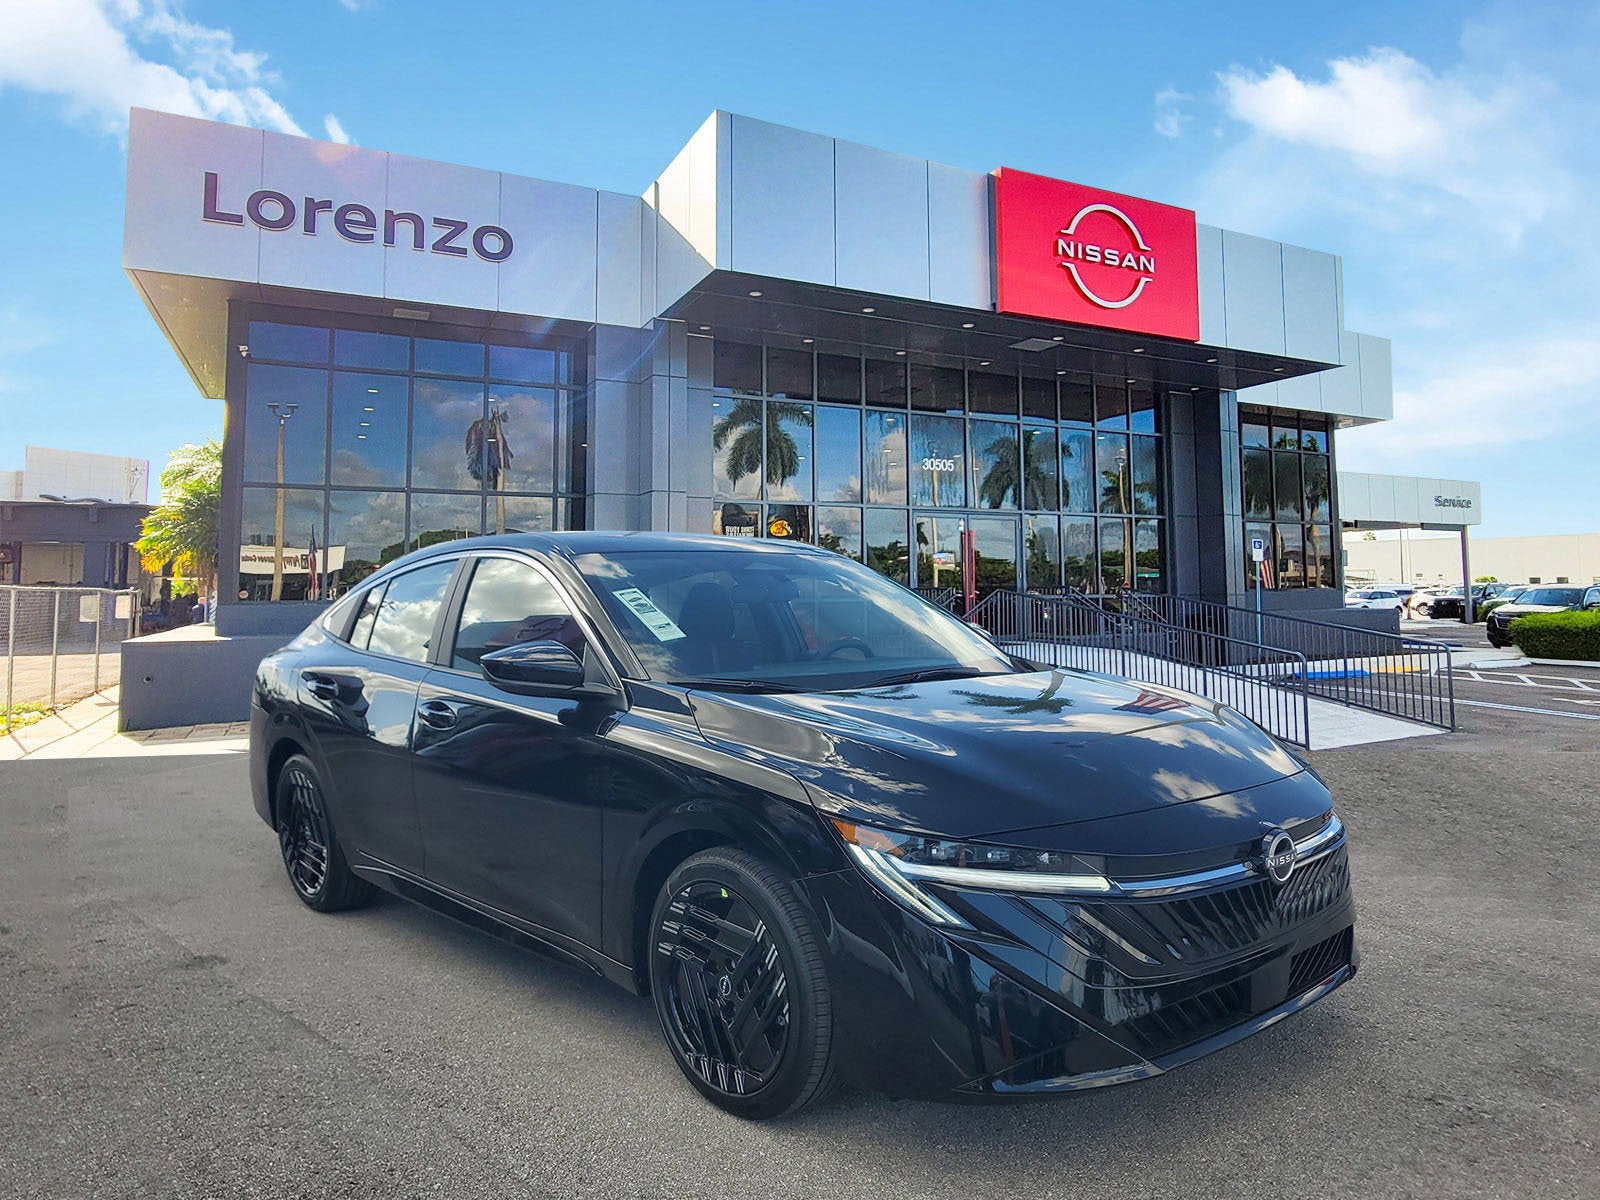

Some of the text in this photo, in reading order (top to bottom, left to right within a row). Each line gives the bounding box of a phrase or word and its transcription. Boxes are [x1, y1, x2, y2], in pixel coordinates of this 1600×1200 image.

[203, 171, 514, 262] Lorenzo
[1057, 238, 1155, 273] NISSAN
[922, 458, 955, 471] 30505
[1434, 495, 1472, 508] Service
[1266, 853, 1297, 868] NISSA
